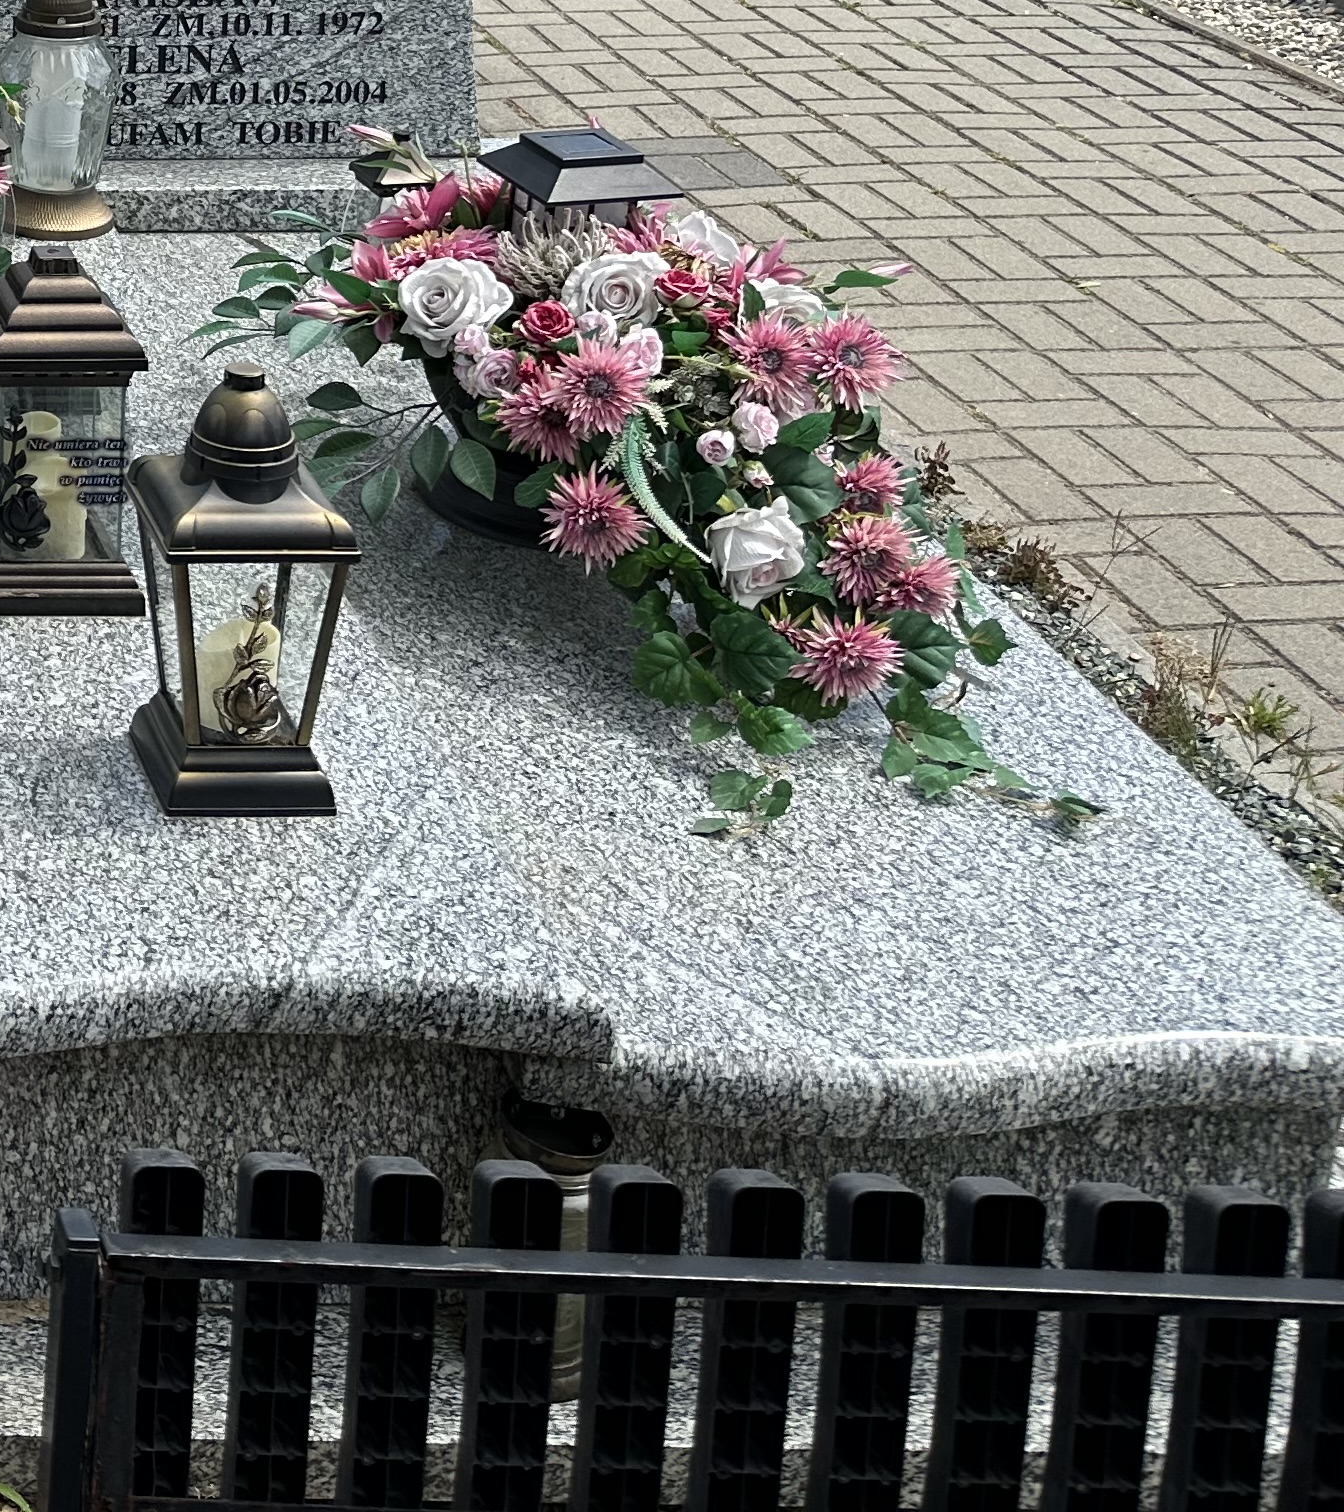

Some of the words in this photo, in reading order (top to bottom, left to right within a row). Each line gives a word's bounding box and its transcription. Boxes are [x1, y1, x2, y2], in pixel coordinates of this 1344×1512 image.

[317, 11, 386, 37] 1972
[107, 122, 203, 148] UFAM
[232, 120, 343, 146] TOBIE
[27, 438, 51, 451] Nie
[54, 438, 100, 451] umiera
[70, 456, 93, 468] kto
